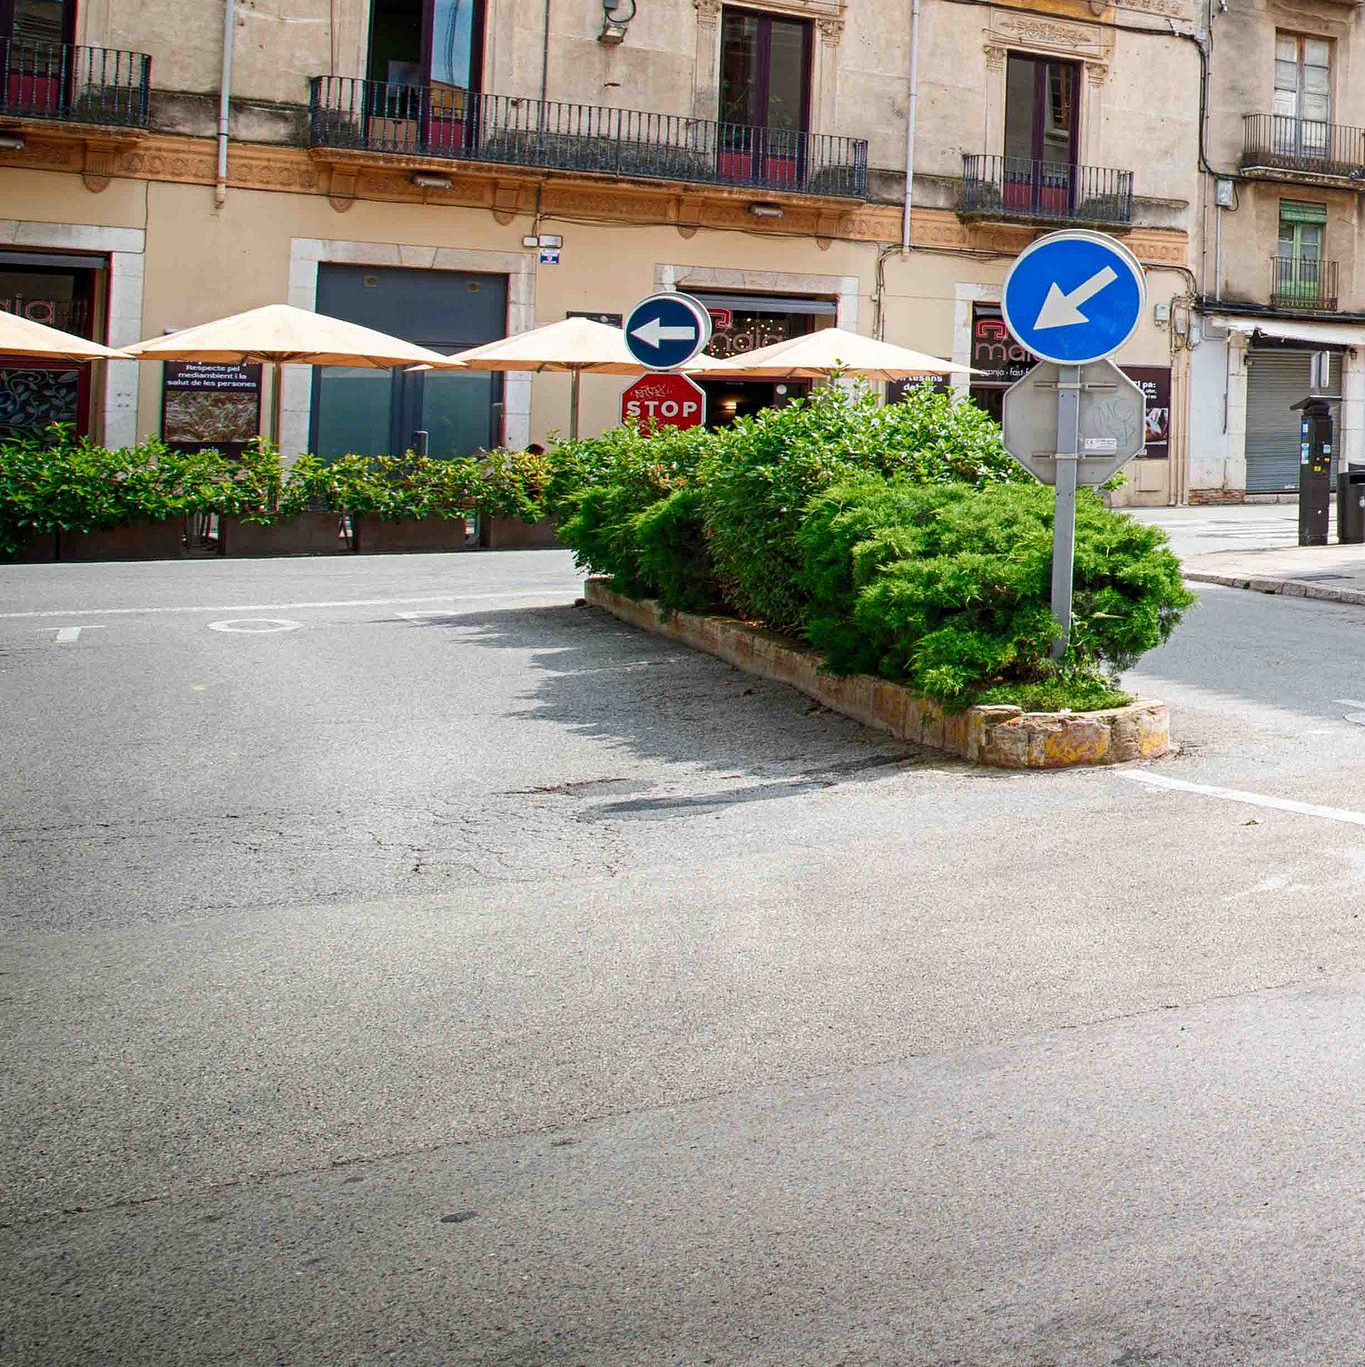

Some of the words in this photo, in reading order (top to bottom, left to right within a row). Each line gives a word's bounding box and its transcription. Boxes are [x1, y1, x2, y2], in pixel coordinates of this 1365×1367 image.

[185, 364, 226, 372] Respecte
[227, 365, 241, 373] pel
[217, 380, 257, 388] persones
[627, 400, 698, 418] STOP
